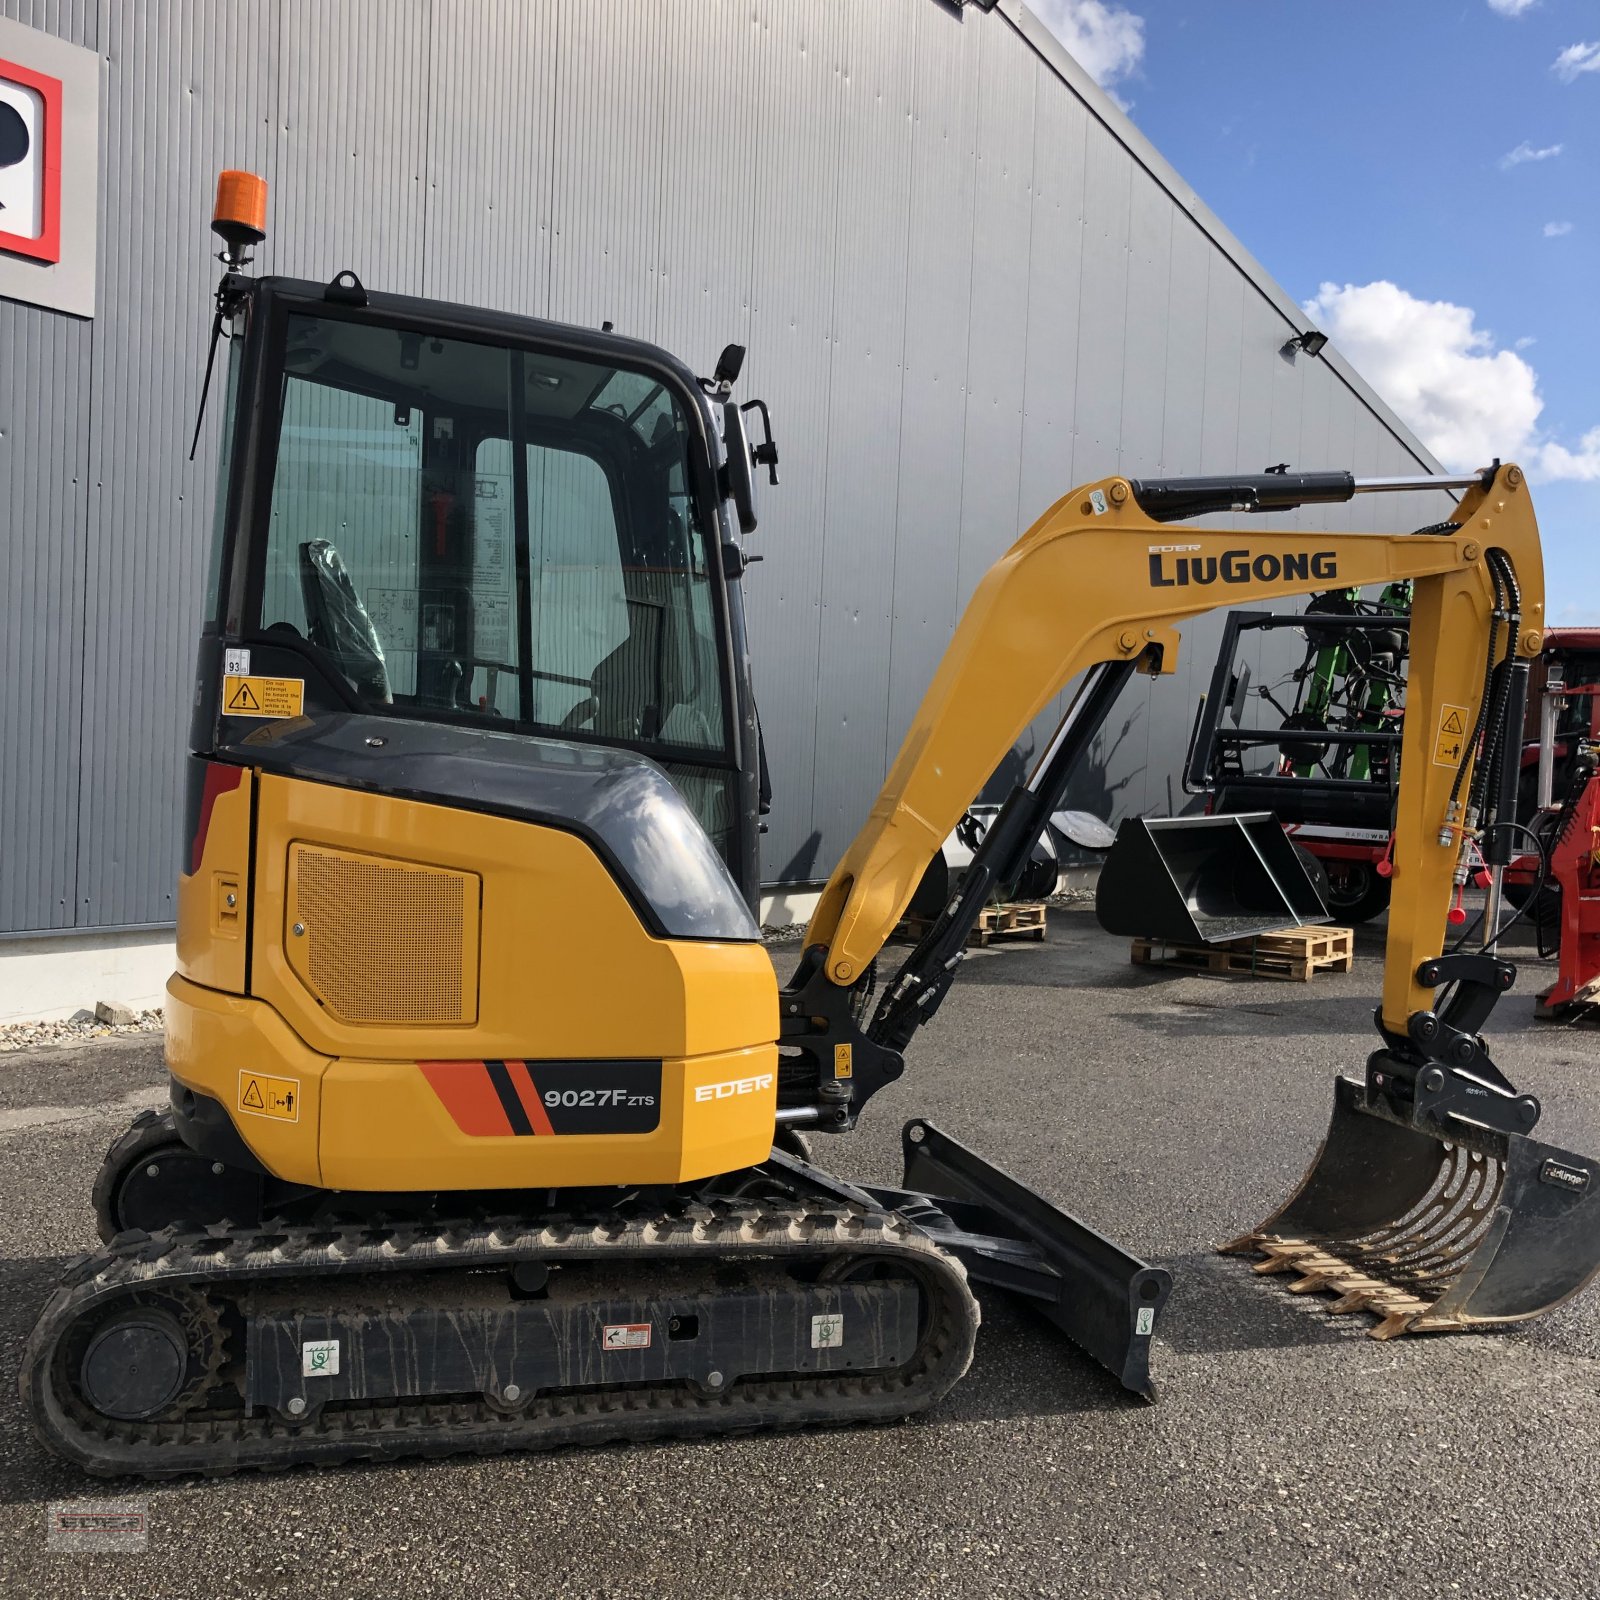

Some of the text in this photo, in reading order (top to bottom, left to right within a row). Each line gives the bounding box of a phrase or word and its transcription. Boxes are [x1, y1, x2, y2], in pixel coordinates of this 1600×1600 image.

[1148, 544, 1201, 553] EDER
[1148, 550, 1337, 587] LIUGONG
[229, 662, 240, 672] 93
[694, 1073, 773, 1102] EDER
